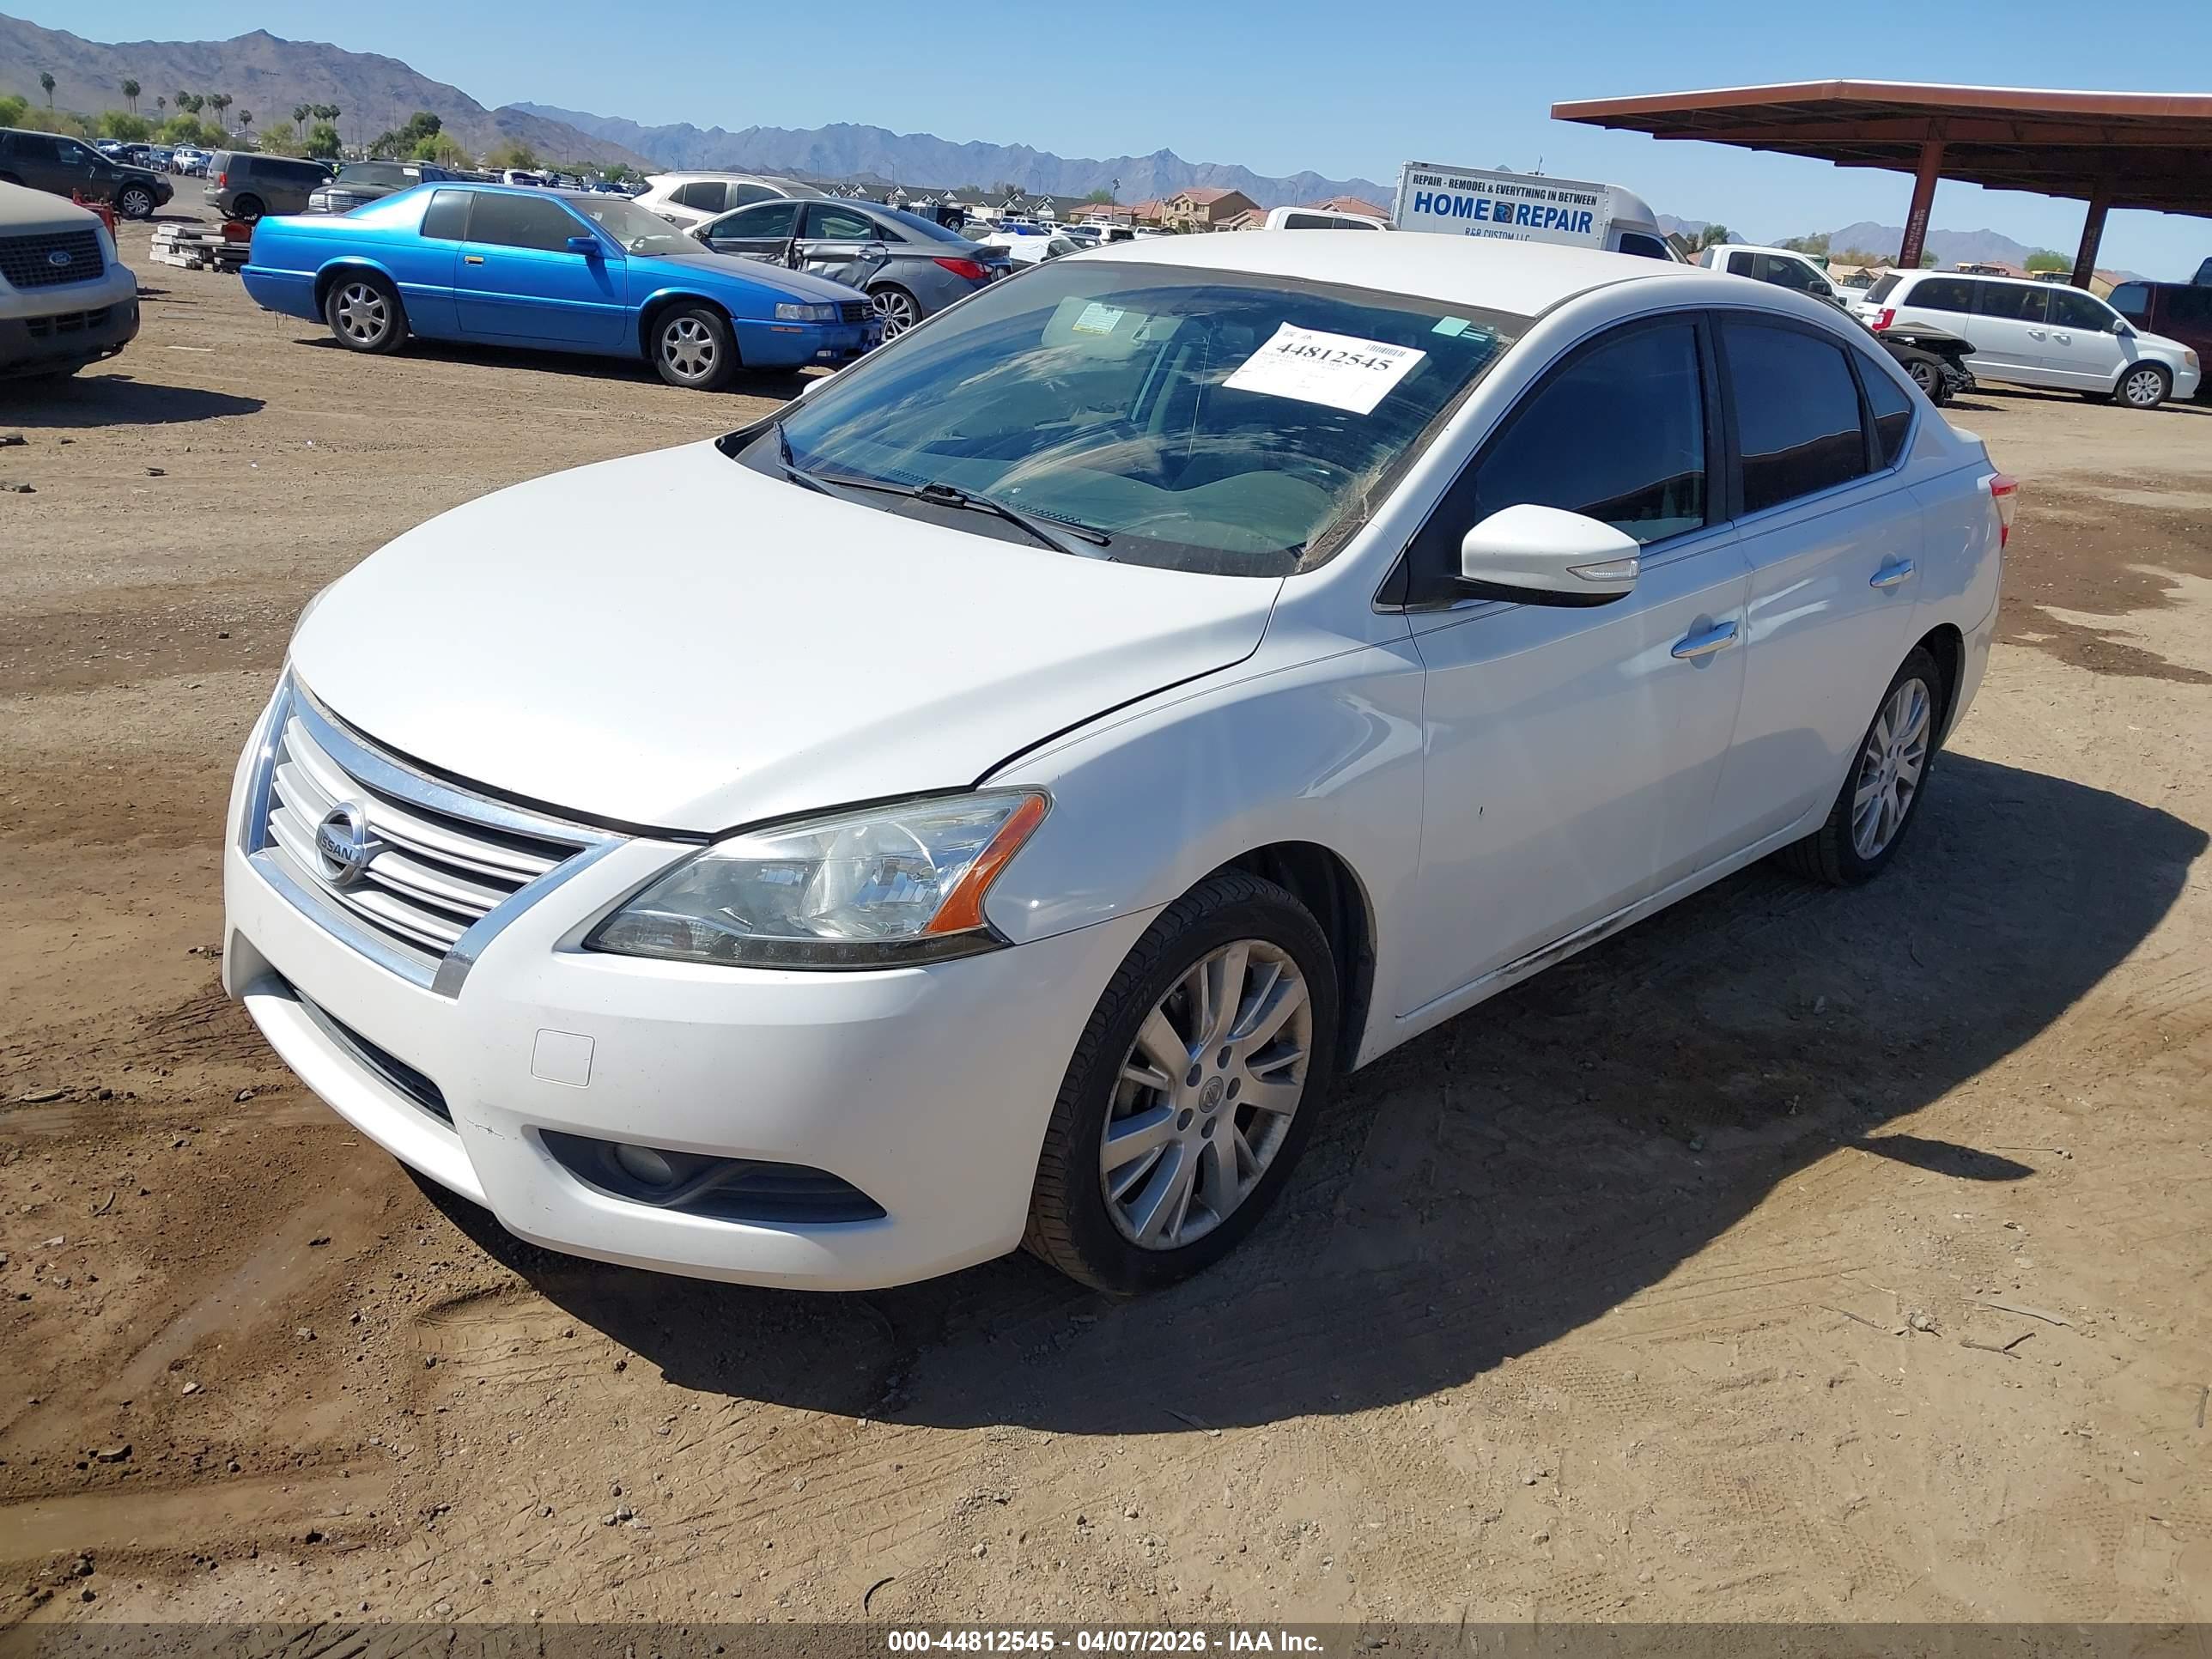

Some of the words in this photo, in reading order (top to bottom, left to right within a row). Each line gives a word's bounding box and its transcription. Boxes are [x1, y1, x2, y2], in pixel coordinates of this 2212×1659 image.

[1413, 174, 1443, 187] REPAIR
[1449, 178, 1486, 192] REMODEL
[1487, 184, 1494, 193] &
[1495, 184, 1547, 200] EVERYTHING
[1547, 191, 1558, 202] IN
[1559, 191, 1597, 206] BETWEEN
[1413, 191, 1491, 221] HOME
[1515, 204, 1594, 234] REPAIR
[1276, 343, 1394, 371] 44812545
[316, 830, 353, 861] NISSAN
